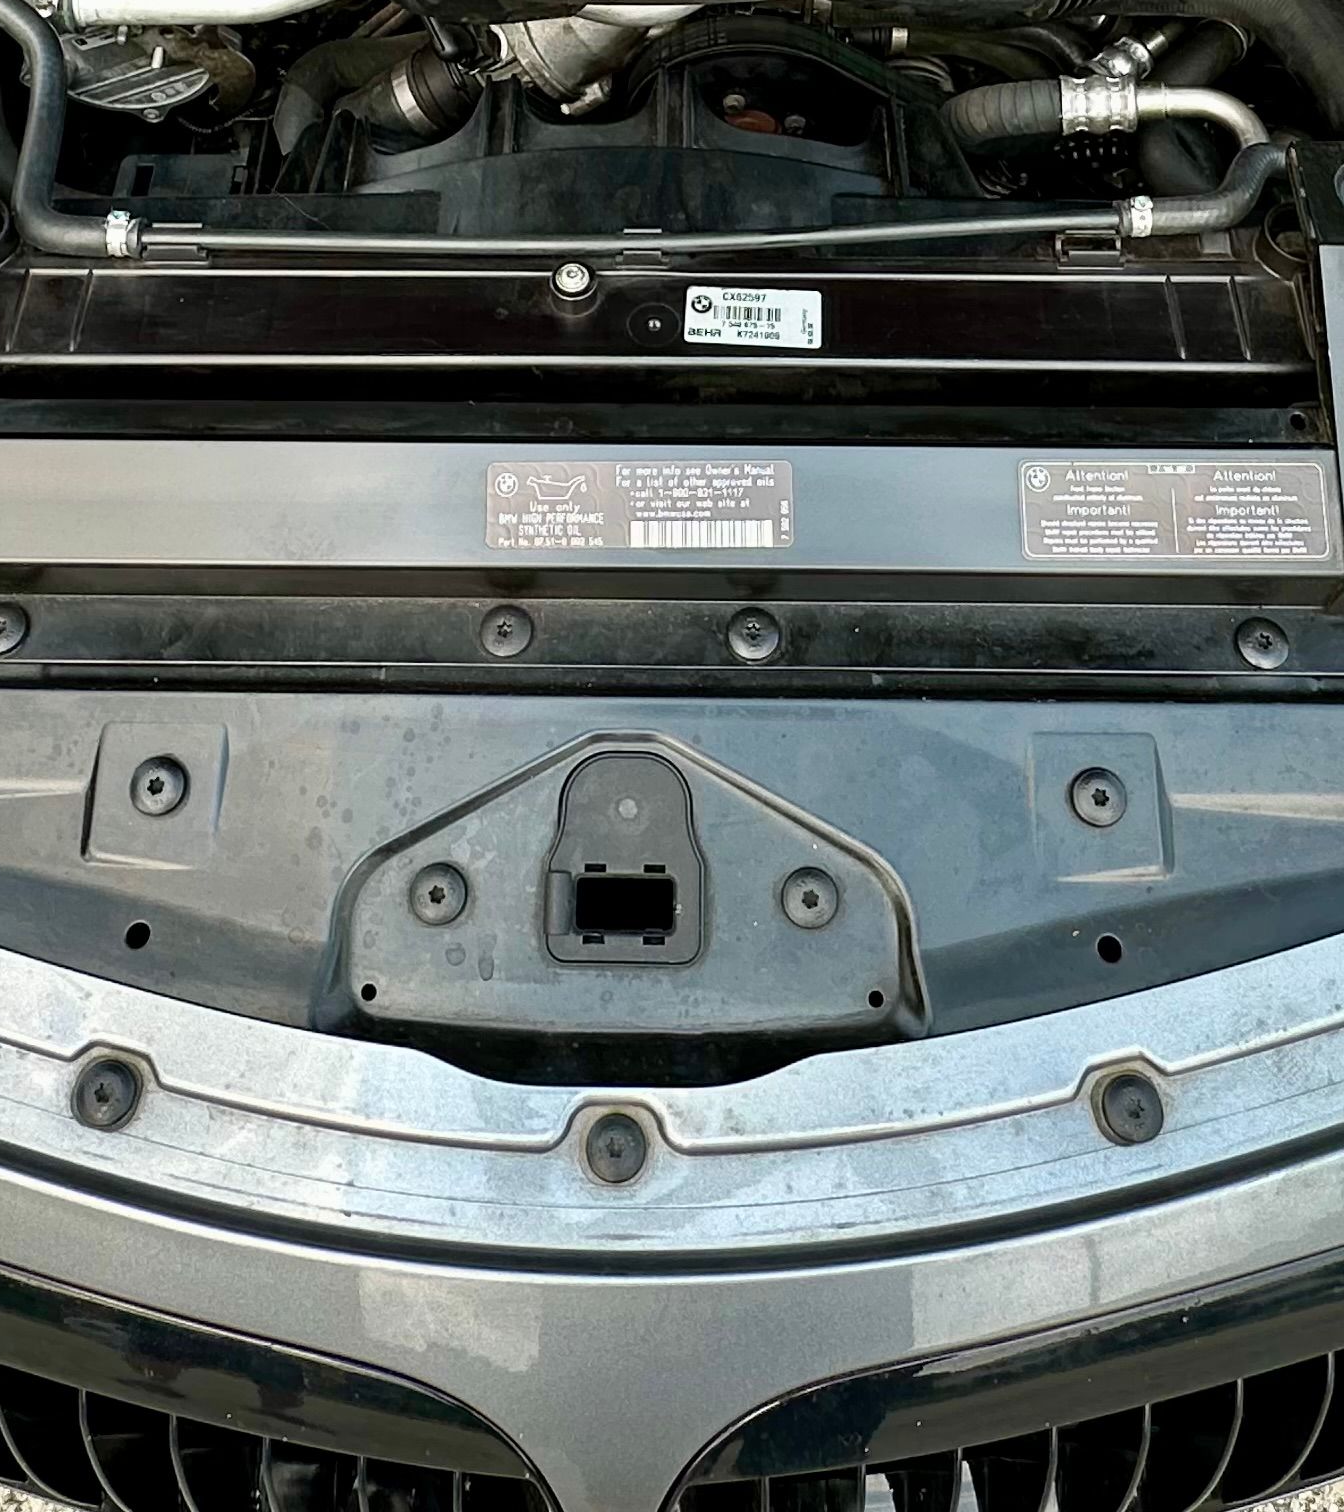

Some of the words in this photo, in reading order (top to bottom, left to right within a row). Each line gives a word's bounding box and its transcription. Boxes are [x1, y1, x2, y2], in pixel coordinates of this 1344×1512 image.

[688, 327, 722, 337] BEHR
[616, 465, 630, 476] For
[636, 467, 658, 476] more
[662, 465, 681, 476] info
[686, 467, 701, 476] see
[706, 464, 739, 477] Owner's
[744, 464, 774, 476] Manual
[1065, 469, 1129, 482] Attention!
[1213, 470, 1277, 481] Attention!
[616, 477, 631, 488] For
[647, 477, 663, 487] list
[668, 477, 679, 487] of
[683, 477, 707, 487] other
[712, 477, 752, 489] approved
[756, 477, 775, 487] oils
[635, 489, 654, 498] call
[529, 500, 550, 513] Use
[555, 501, 581, 515] only
[635, 500, 645, 508] or
[650, 499, 672, 508] visit
[676, 500, 691, 508] our
[717, 499, 736, 508] site
[635, 509, 711, 519] www.bmwusa.com
[1066, 504, 1131, 517] Important!
[1215, 505, 1280, 517] Important!
[498, 512, 518, 525] BMW
[522, 512, 543, 525] HIGH
[545, 512, 605, 525] PERFORMANCE
[518, 525, 564, 537] SYNTHETIC
[567, 525, 582, 537] OIL
[498, 537, 515, 548] Part
[518, 537, 531, 547] No.
